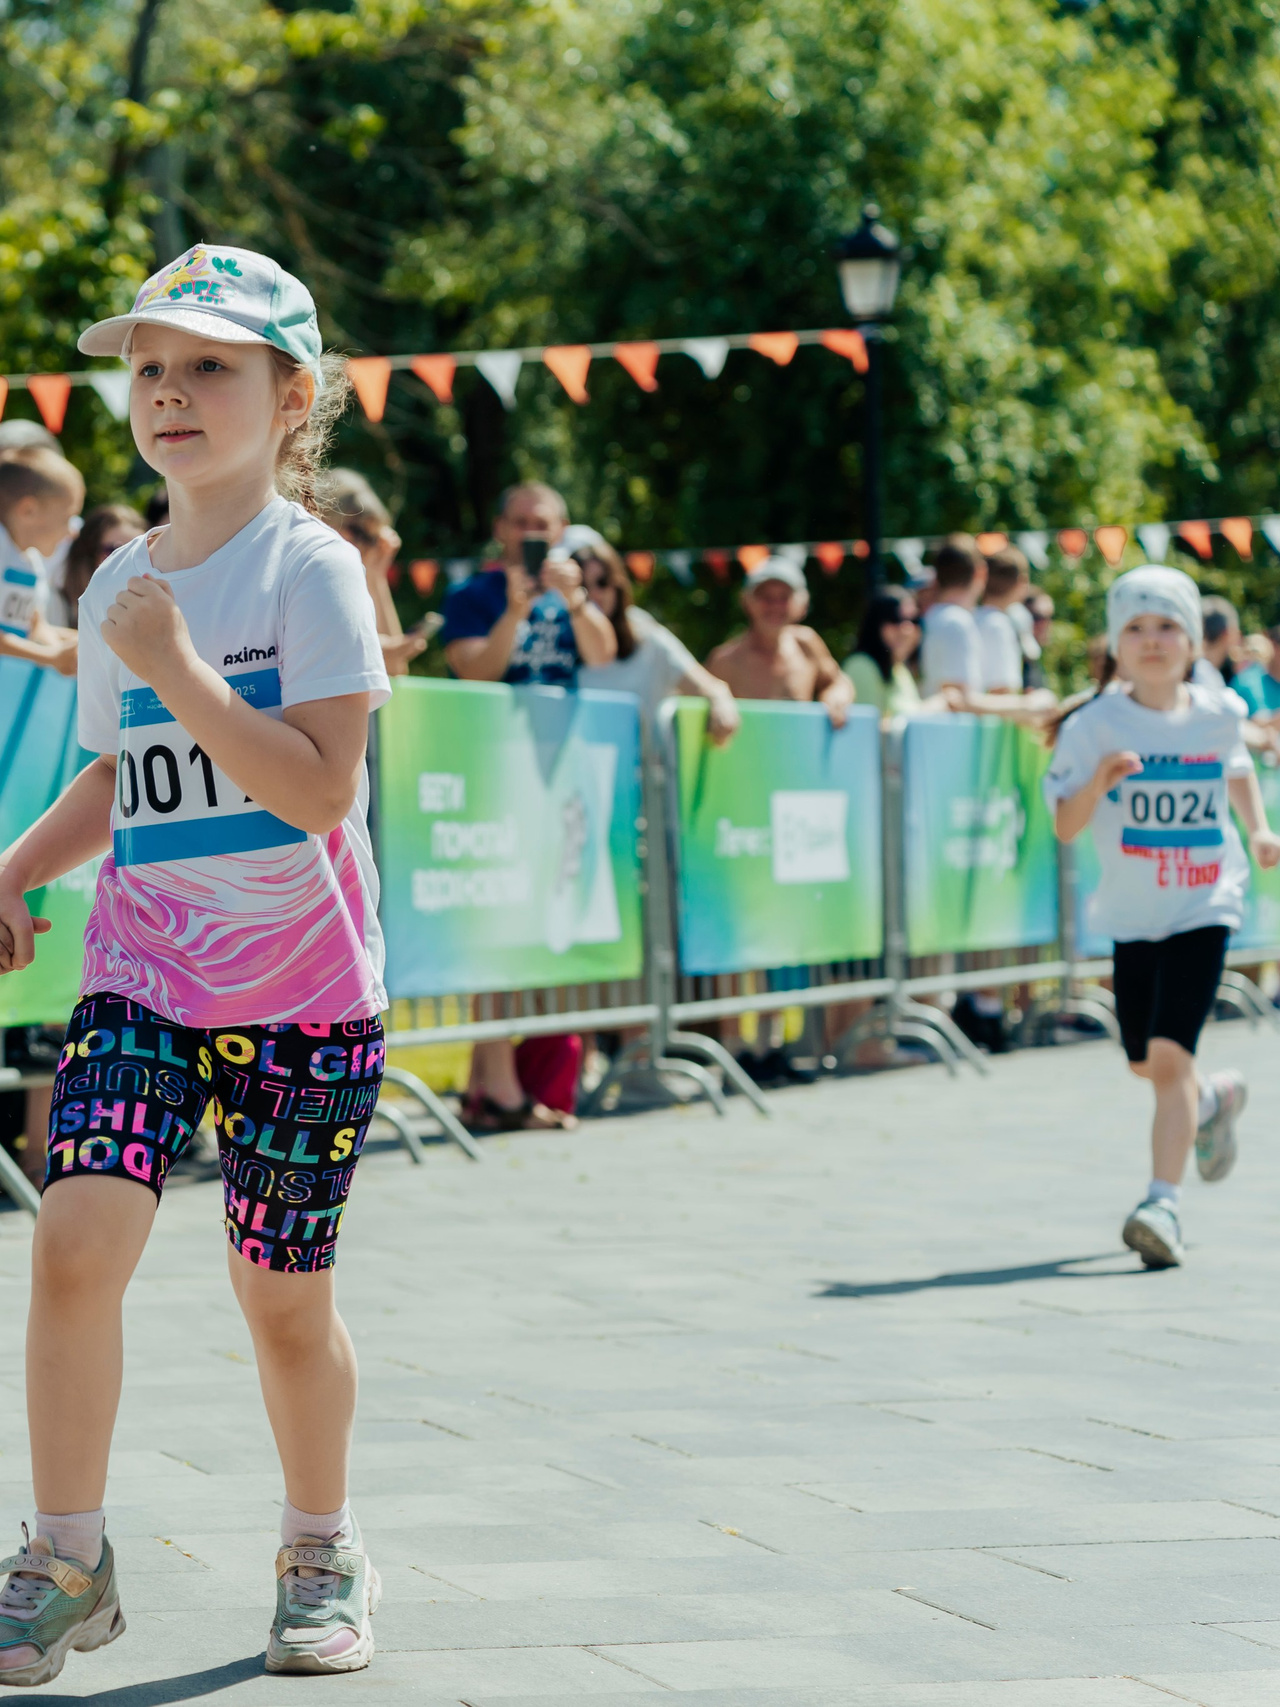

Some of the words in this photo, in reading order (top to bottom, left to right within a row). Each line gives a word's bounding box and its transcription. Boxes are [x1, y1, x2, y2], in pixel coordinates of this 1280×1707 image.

[119, 742, 253, 819] 001
[1130, 788, 1217, 824] 0024
[46, 1136, 155, 1182] DOL
